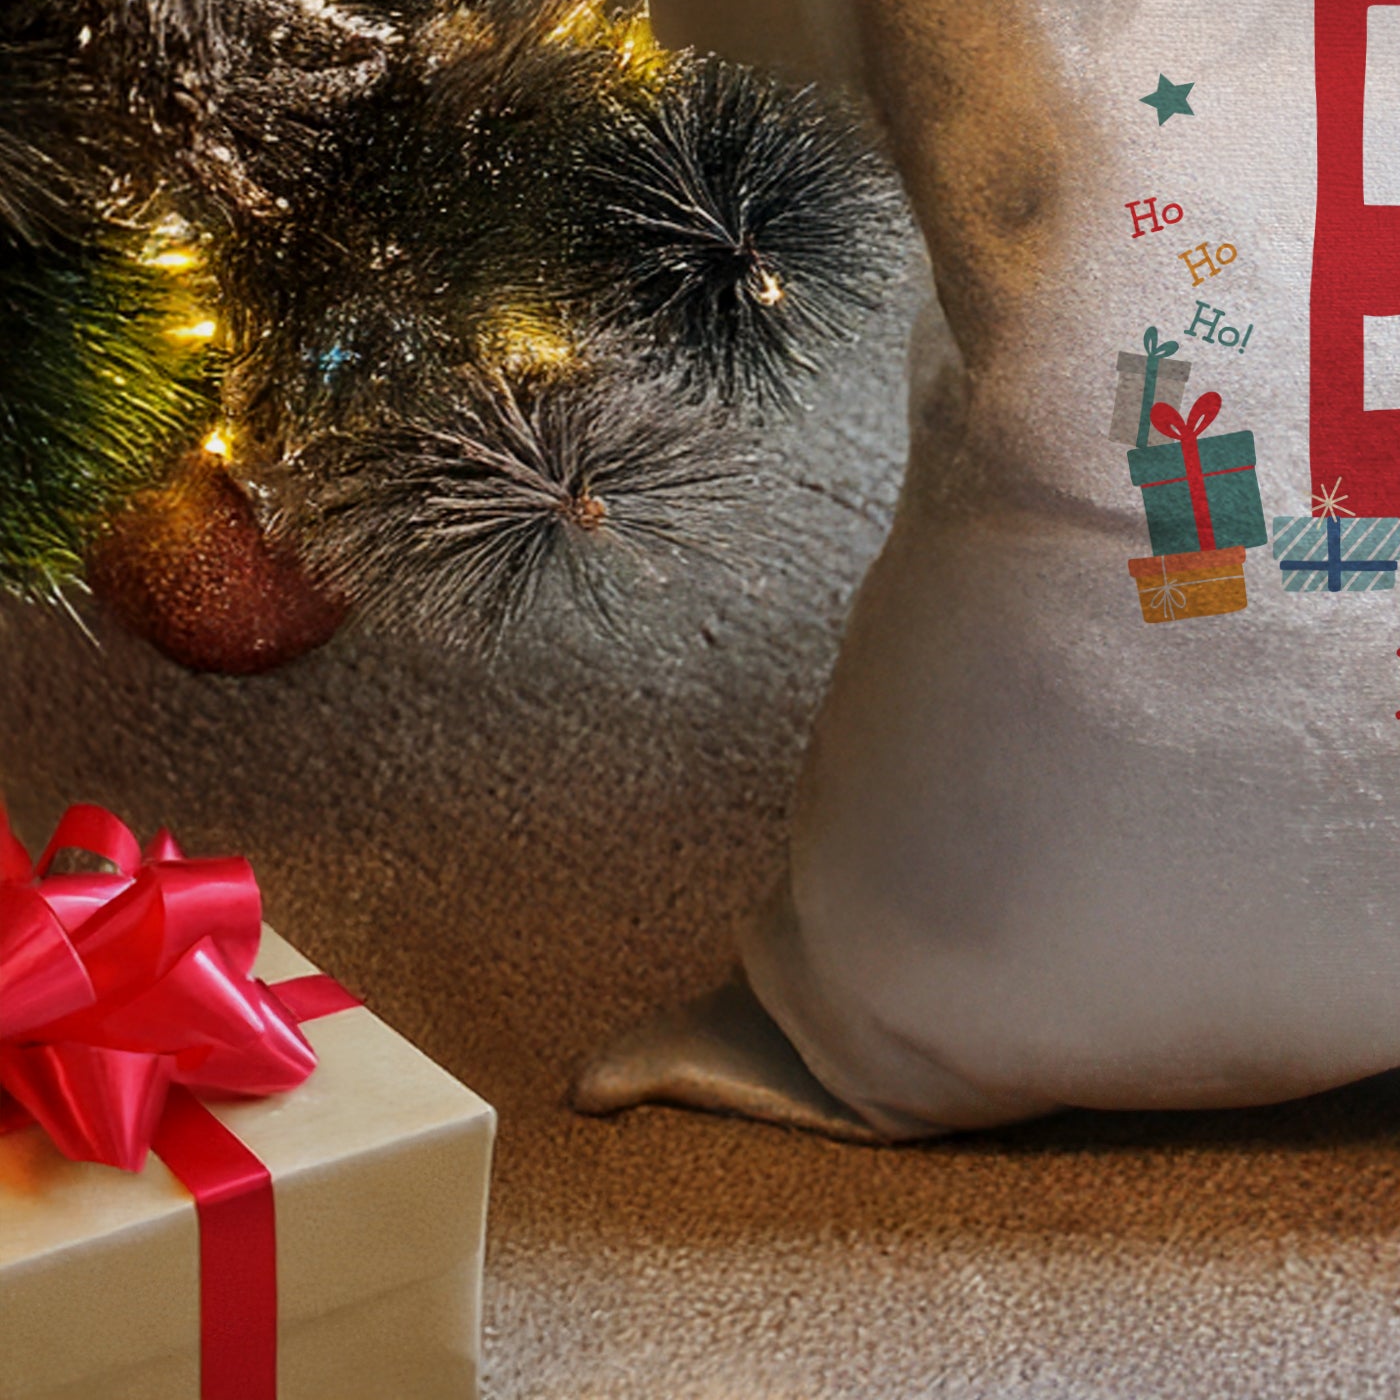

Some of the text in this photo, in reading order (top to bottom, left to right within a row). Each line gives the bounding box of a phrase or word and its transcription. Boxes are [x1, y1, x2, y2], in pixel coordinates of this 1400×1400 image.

[1124, 197, 1184, 239] Ho
[1177, 242, 1238, 287] Ho
[1183, 300, 1254, 354] Ho!
